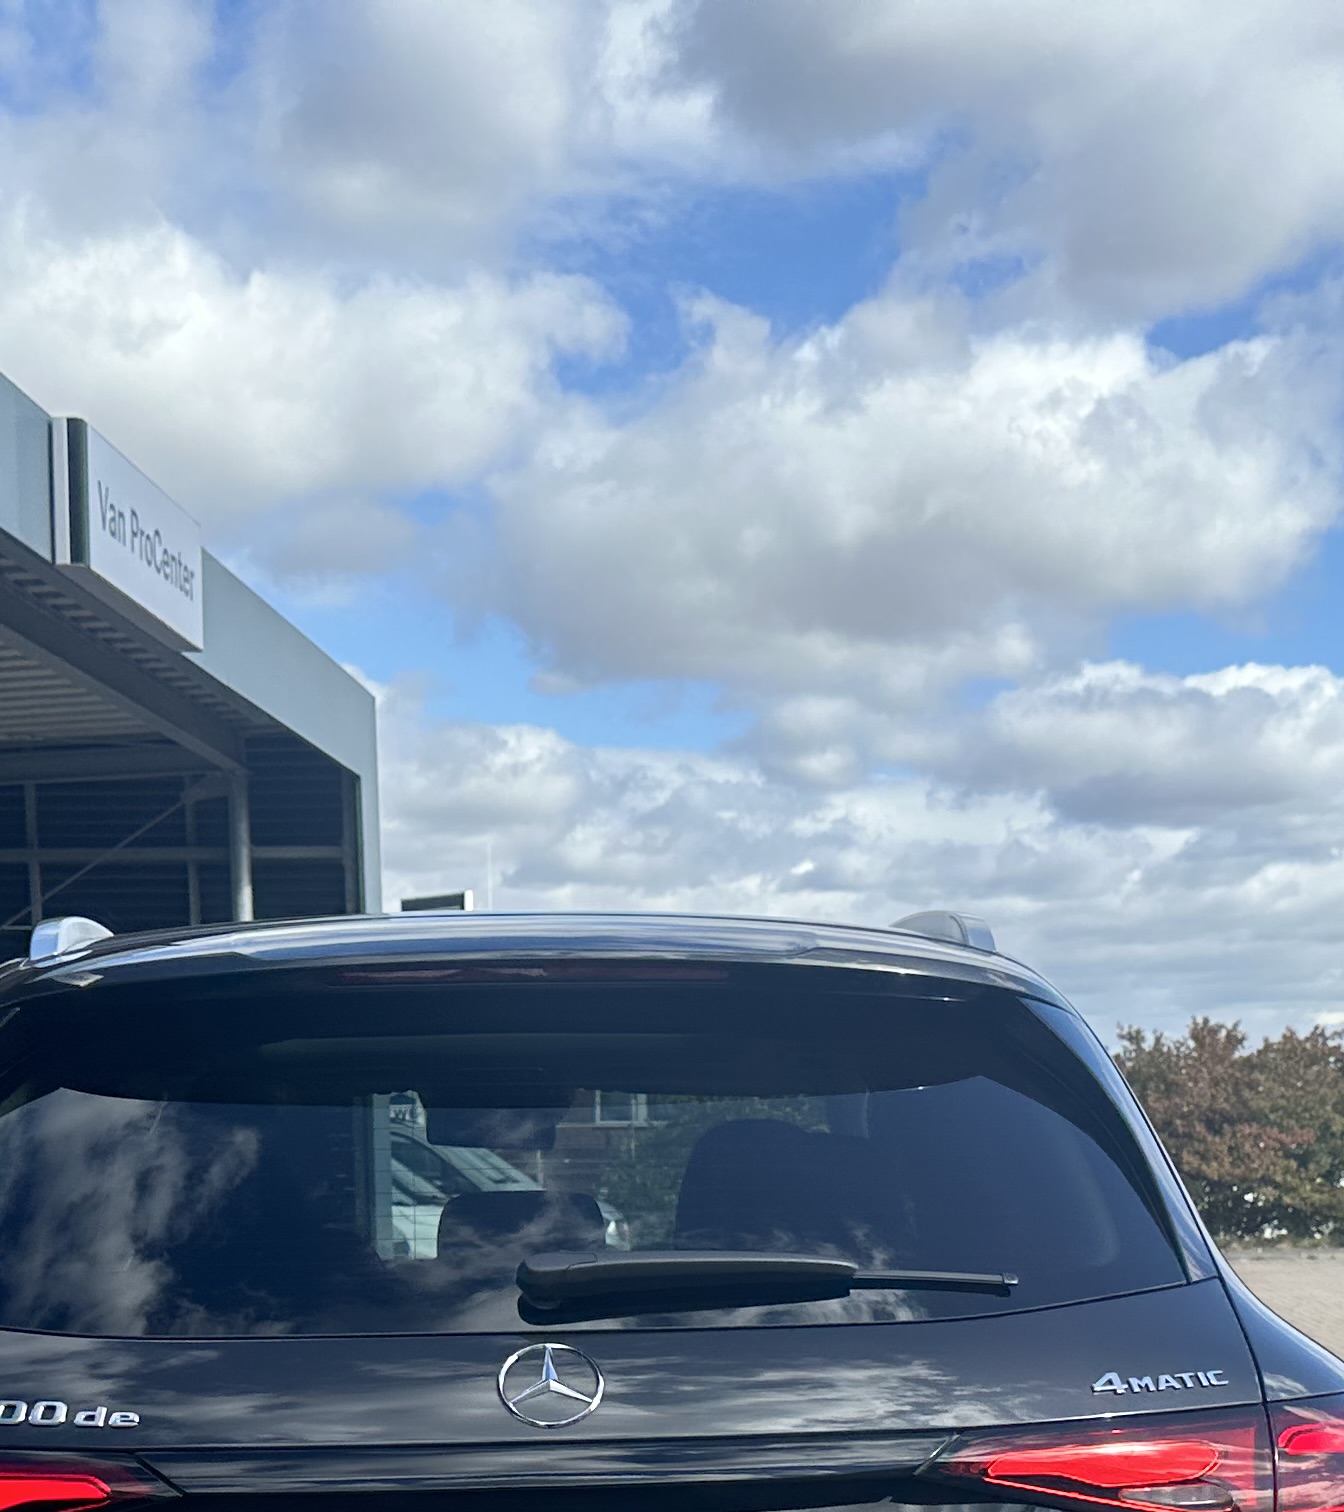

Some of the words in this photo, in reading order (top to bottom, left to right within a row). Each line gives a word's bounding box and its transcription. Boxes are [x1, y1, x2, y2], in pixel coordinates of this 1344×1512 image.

[97, 480, 126, 546] Van
[130, 507, 195, 601] ProCenter
[1092, 1369, 1230, 1394] 4MATIC
[73, 1406, 140, 1428] de
